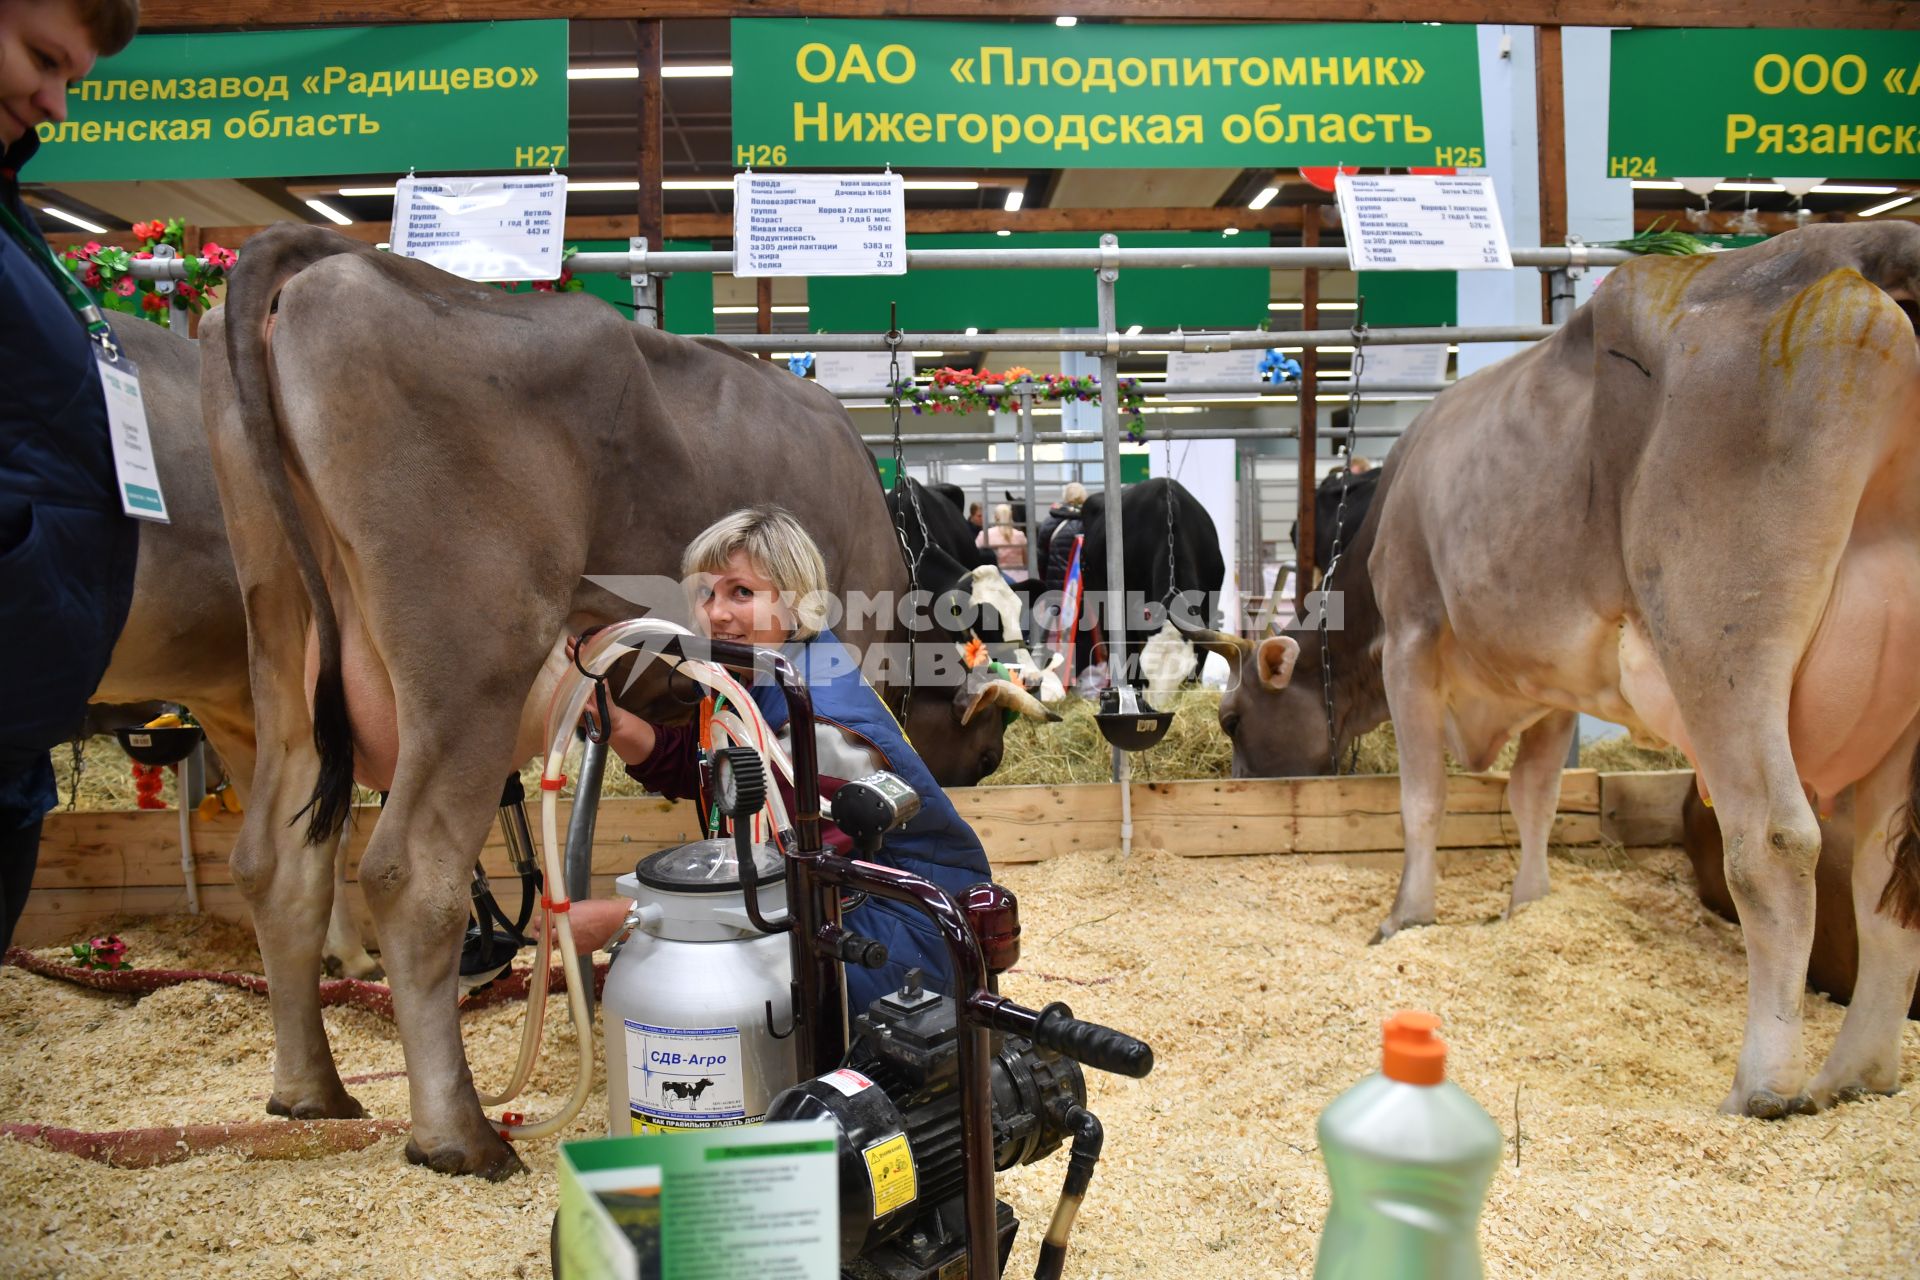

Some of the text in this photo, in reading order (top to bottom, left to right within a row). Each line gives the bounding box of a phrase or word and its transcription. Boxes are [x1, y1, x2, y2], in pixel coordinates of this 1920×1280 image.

[302, 66, 539, 97] «Радищево»
[796, 43, 1425, 93] ОАО «Плодопитомник»
[1754, 53, 1867, 95] ООО
[223, 109, 381, 138] область
[794, 101, 1432, 153] Нижегородская область
[750, 234, 816, 242] Продуктивность
[777, 243, 798, 251] дней
[651, 1051, 727, 1067] СДВ-Агро
[666, 1120, 710, 1128] ПРАВИЛЬНО
